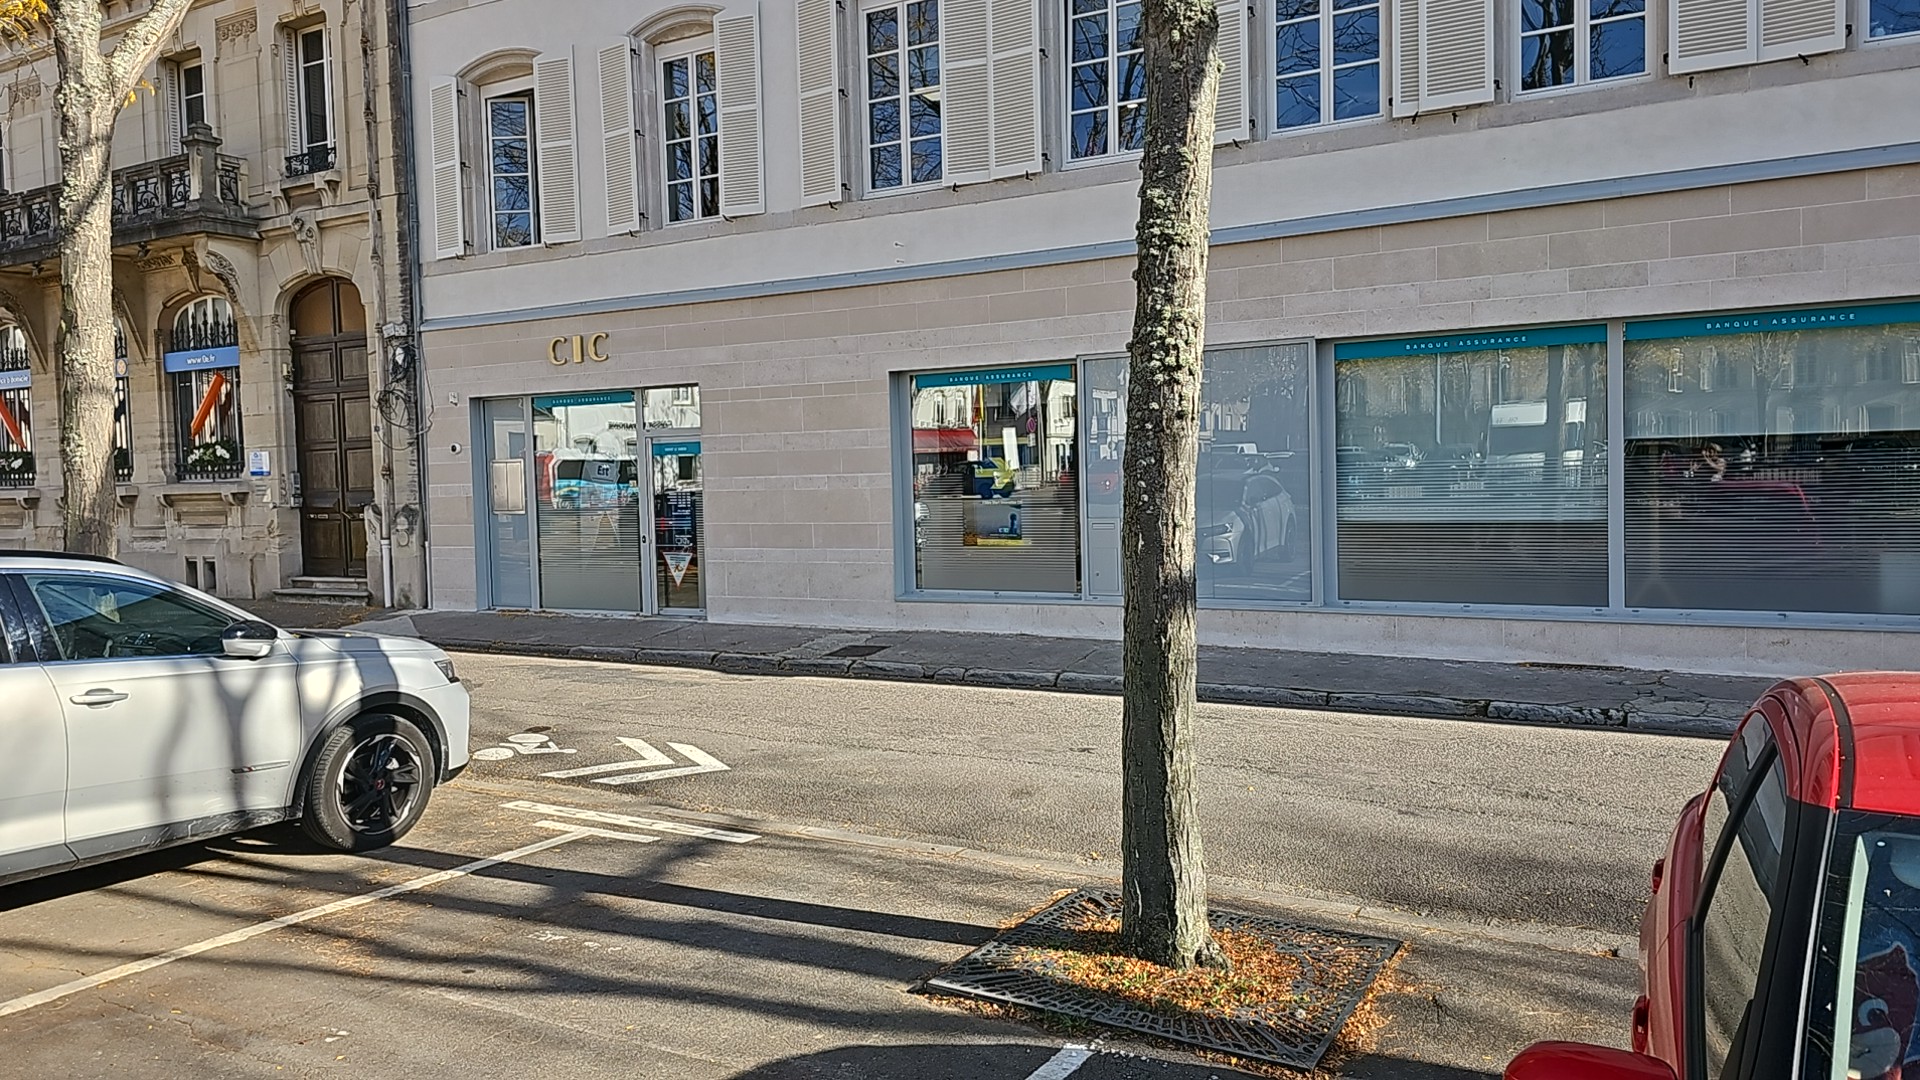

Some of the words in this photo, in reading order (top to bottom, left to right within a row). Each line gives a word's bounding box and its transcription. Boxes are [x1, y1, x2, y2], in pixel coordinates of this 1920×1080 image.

[1706, 319, 1759, 330] BANQUE
[1771, 313, 1856, 325] ASSURANCE
[548, 331, 609, 365] CIC
[1405, 341, 1449, 351] BANQUE
[1458, 335, 1528, 347] ASSURANCE
[949, 375, 979, 383] BANQUE
[985, 371, 1032, 380] ASSURANCE
